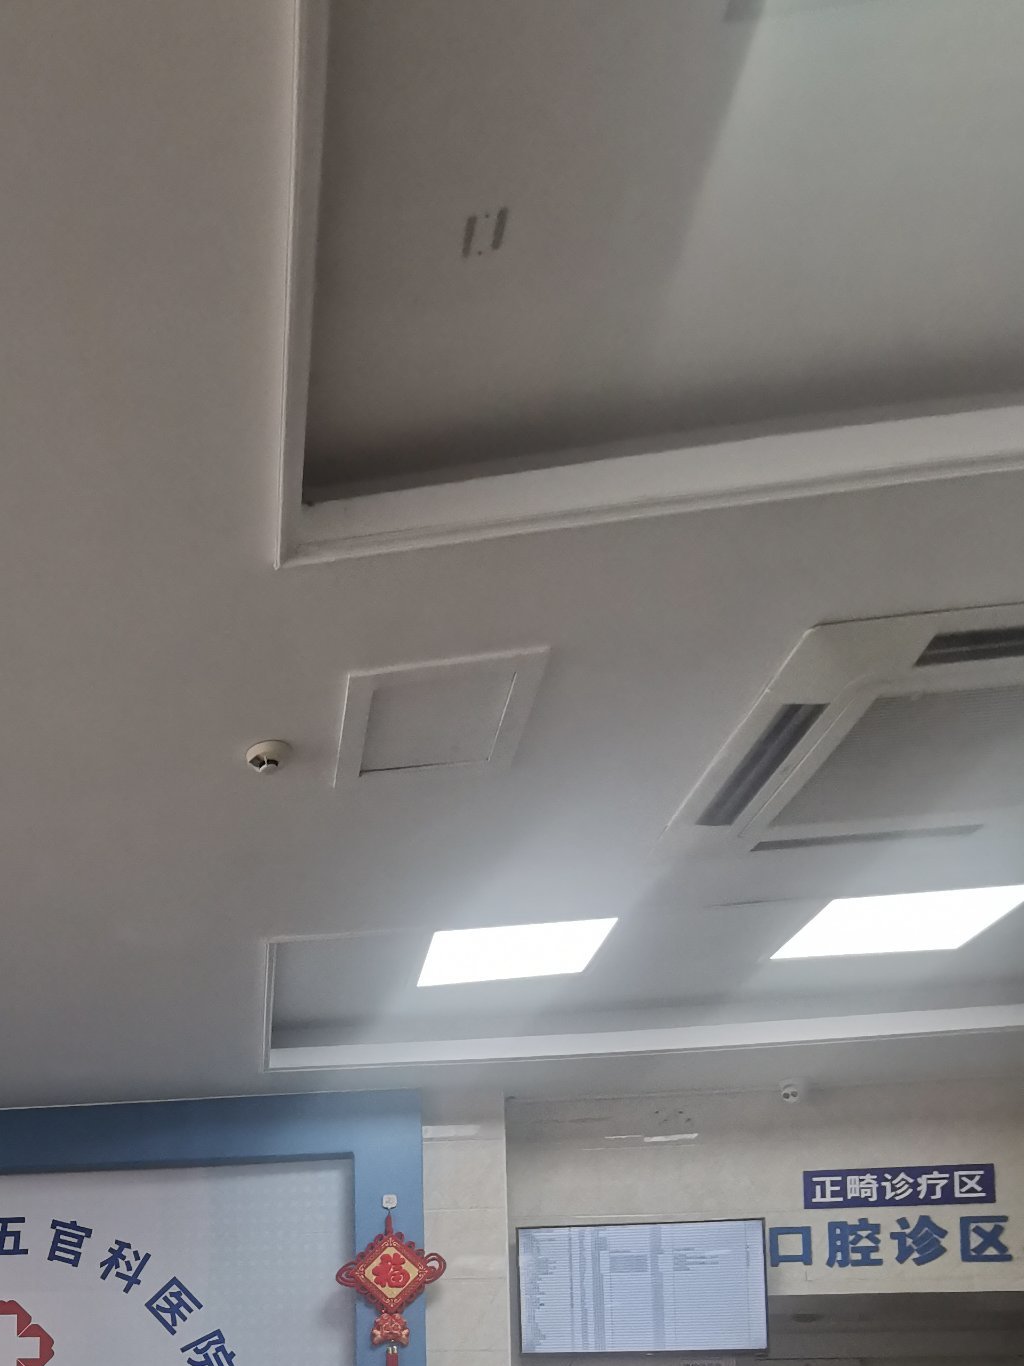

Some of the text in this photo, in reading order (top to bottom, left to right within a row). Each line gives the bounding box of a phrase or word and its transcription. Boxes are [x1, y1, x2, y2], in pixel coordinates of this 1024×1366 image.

[811, 1170, 987, 1202] 正畸诊疗区
[769, 1215, 1013, 1268] 口腔诊区
